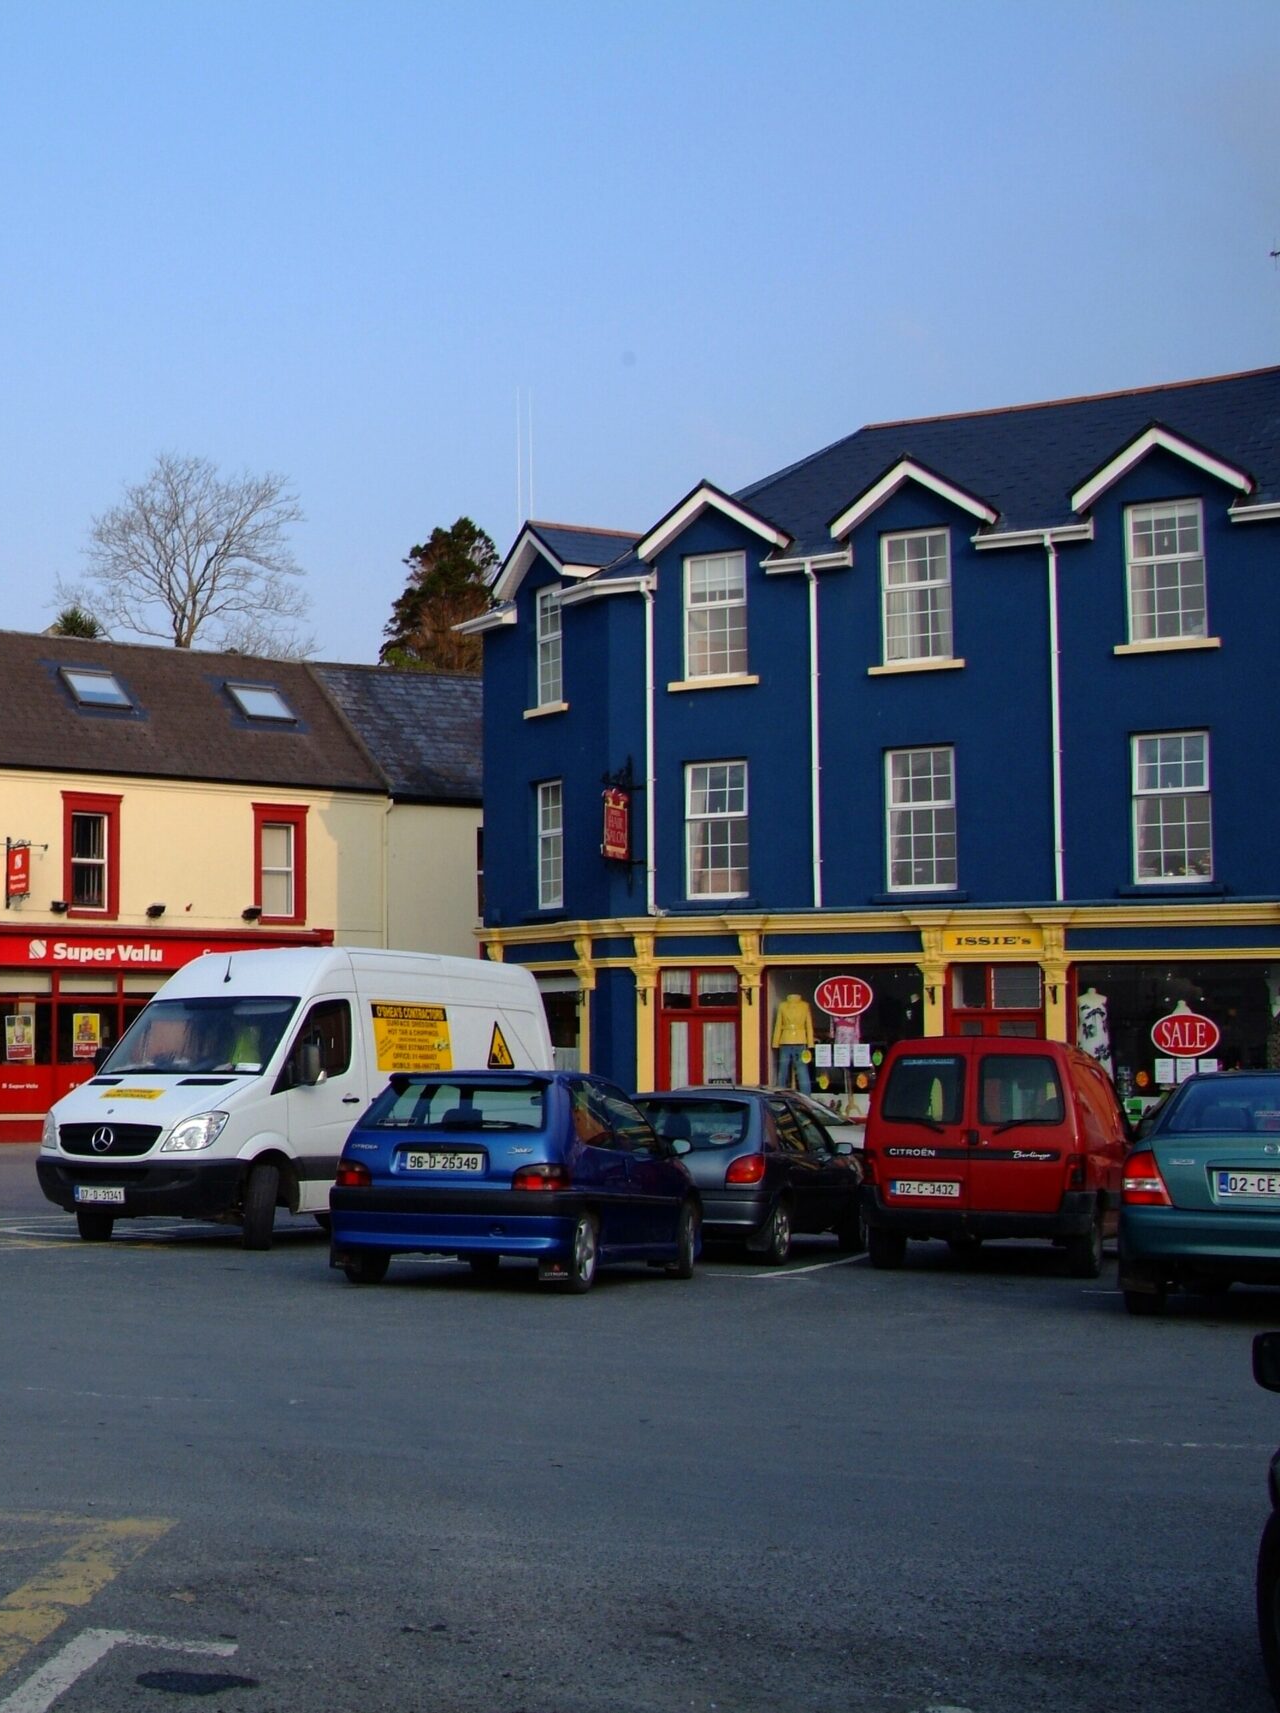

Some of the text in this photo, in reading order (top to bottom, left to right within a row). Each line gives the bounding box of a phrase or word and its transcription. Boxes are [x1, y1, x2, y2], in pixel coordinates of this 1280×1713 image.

[53, 942, 116, 962] Super
[117, 944, 163, 962] Valu
[823, 984, 863, 1009] SALE
[1161, 1021, 1207, 1048] SALE
[1012, 1150, 1052, 1160] Berlingo
[80, 1189, 122, 1200] 07-D-31341
[899, 1182, 955, 1195] 02-C-3432
